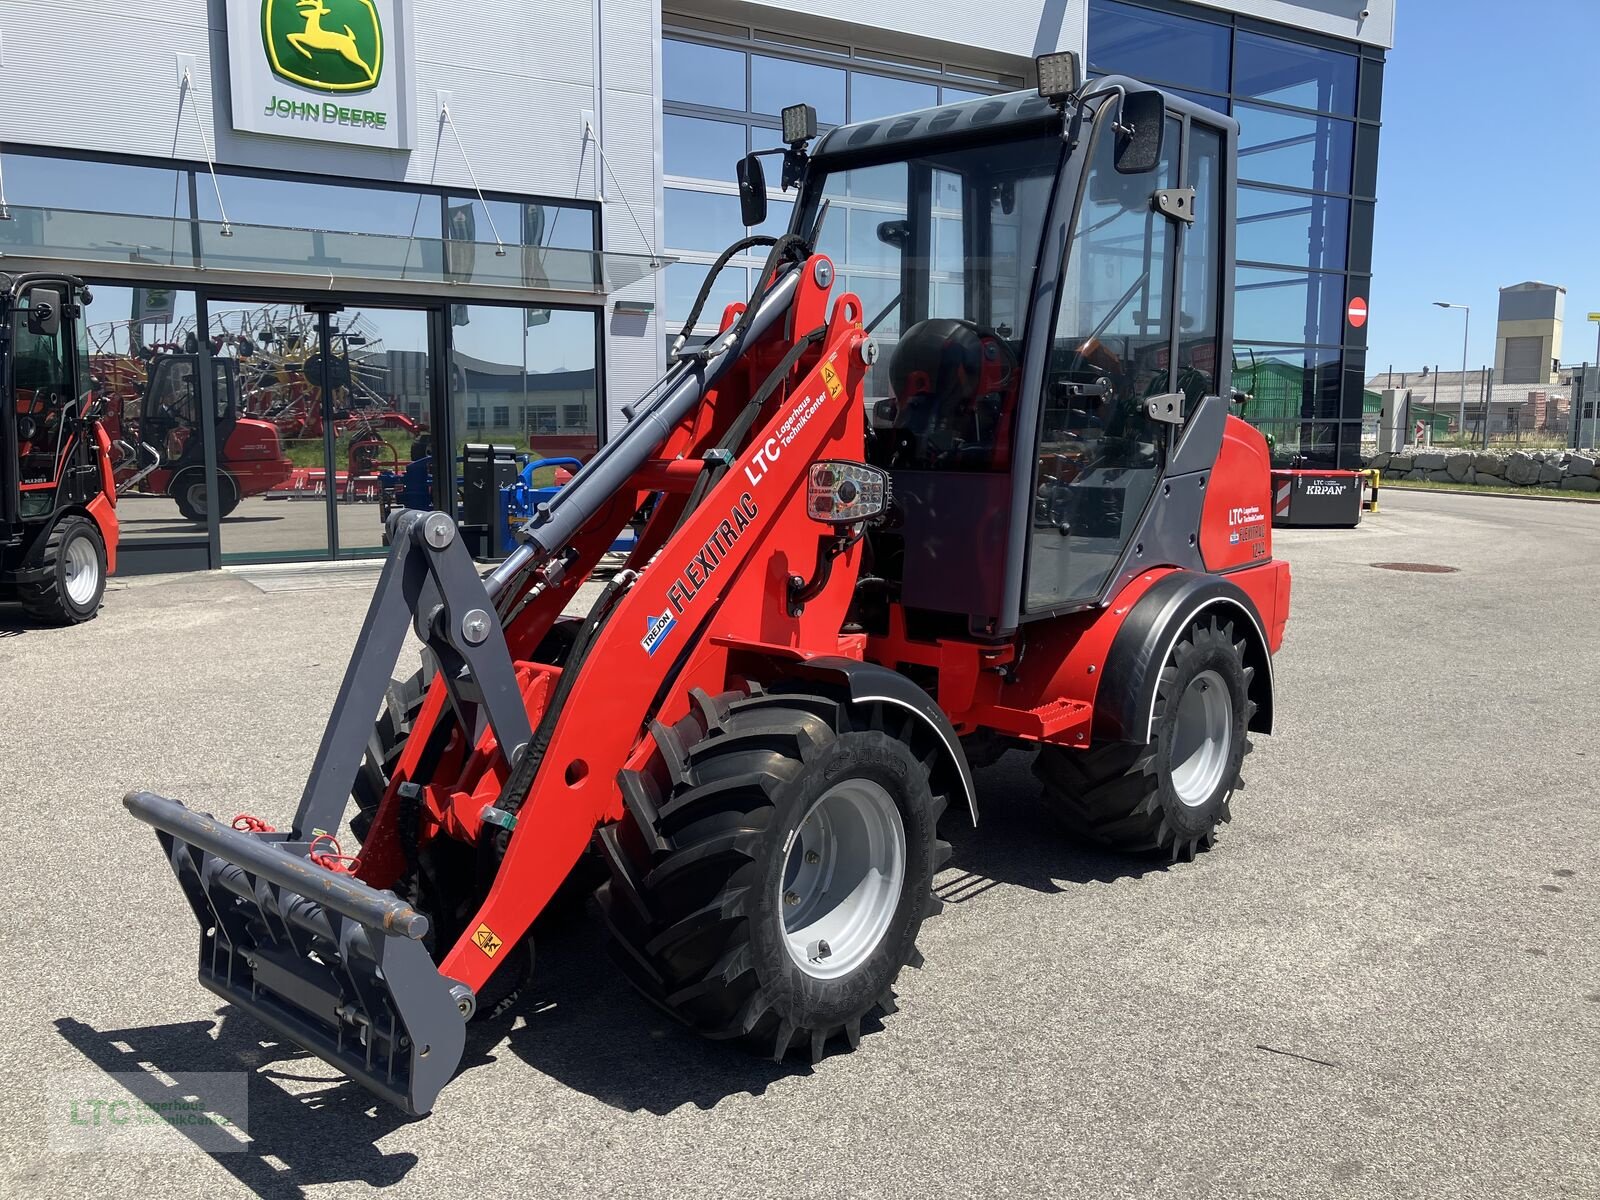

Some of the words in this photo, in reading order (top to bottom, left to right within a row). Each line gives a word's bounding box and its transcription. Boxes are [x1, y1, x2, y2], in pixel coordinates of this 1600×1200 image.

[265, 96, 319, 118] JOHN
[322, 102, 387, 125] DEERE
[775, 395, 811, 439] Lagerhaus
[780, 391, 827, 447] TechnikCenter
[744, 437, 781, 486] LTC
[1306, 485, 1343, 495] KRPAN
[1229, 508, 1243, 525] LTC
[666, 491, 759, 614] FLEXITRAC
[643, 612, 671, 647] TREJON
